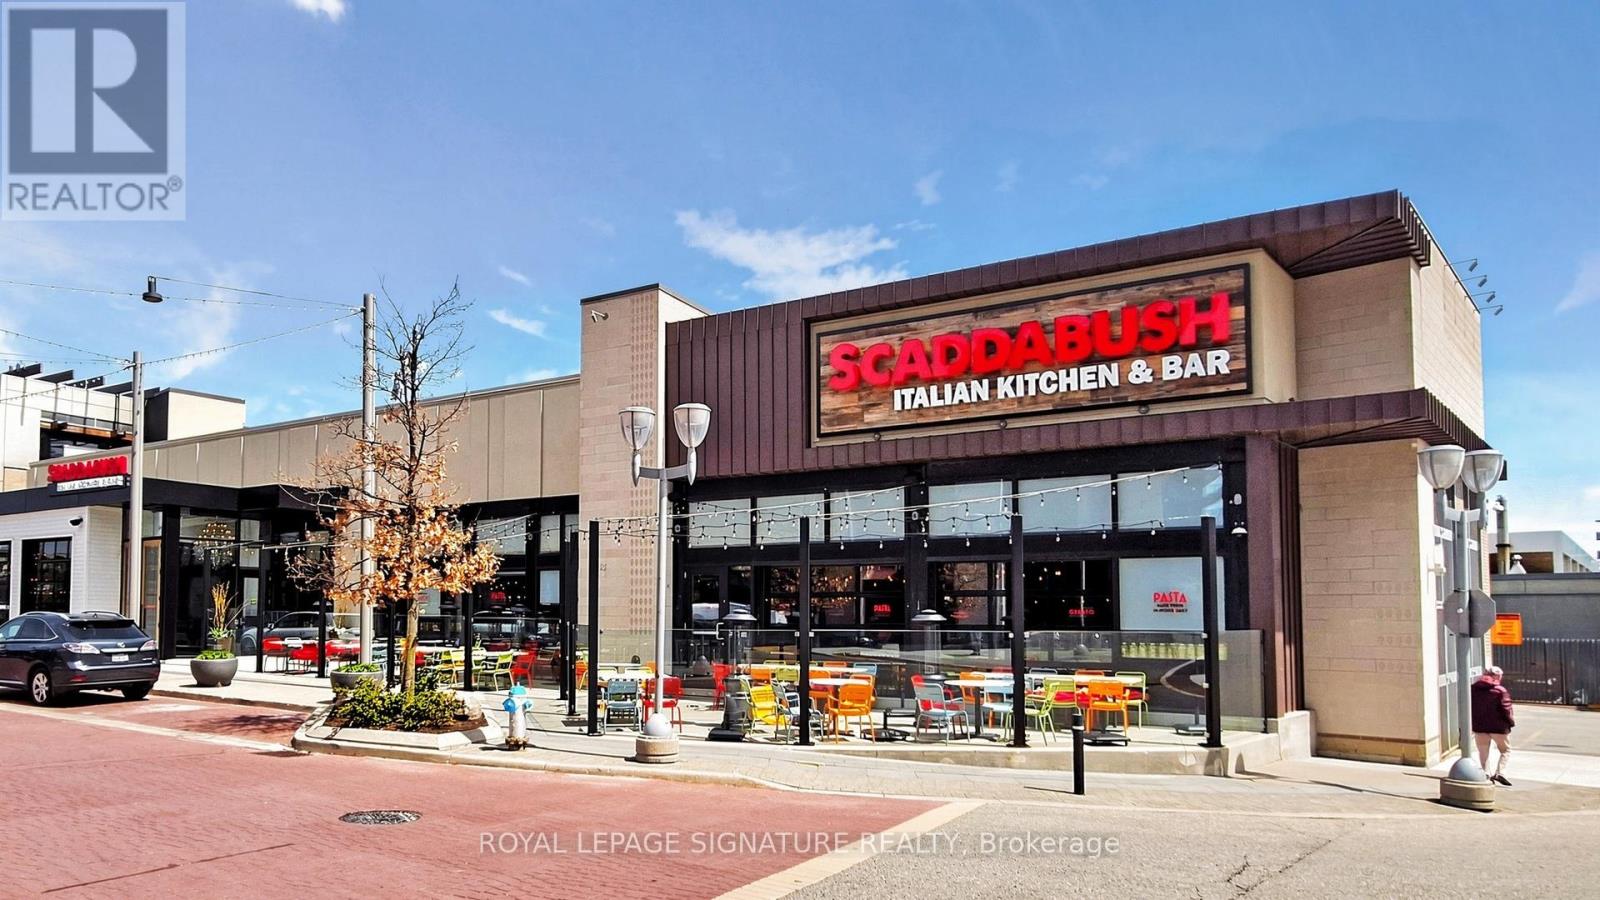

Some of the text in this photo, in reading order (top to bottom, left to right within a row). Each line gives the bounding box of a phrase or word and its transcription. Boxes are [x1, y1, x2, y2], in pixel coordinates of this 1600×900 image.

[828, 291, 1232, 392] SCADDABUSH
[893, 349, 1231, 411] ITALIAN KITCHEN & BAR
[1153, 591, 1188, 603] PASTA
